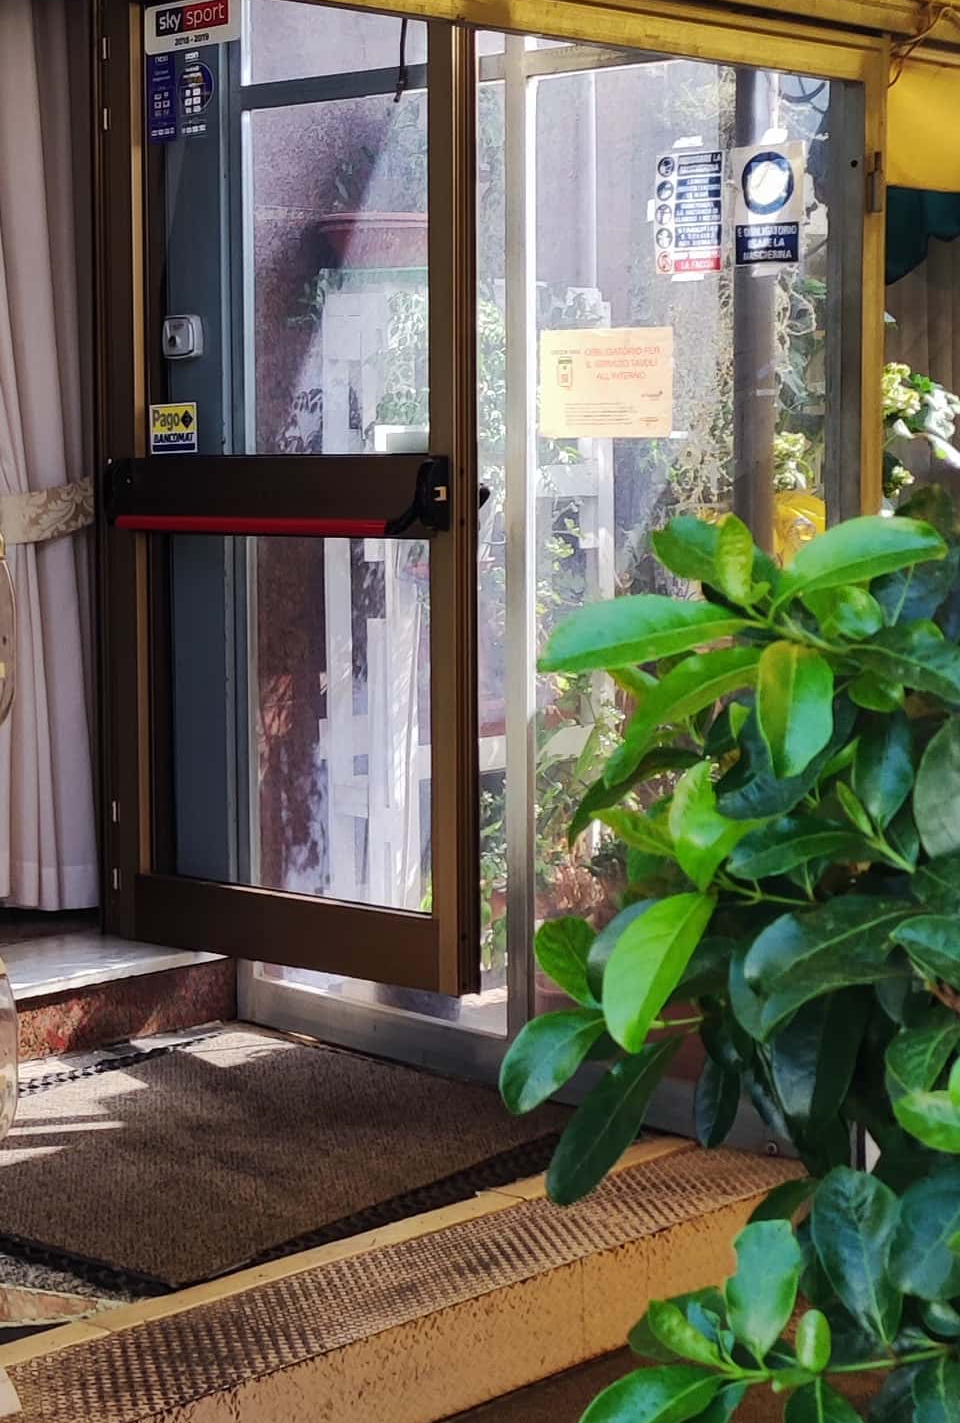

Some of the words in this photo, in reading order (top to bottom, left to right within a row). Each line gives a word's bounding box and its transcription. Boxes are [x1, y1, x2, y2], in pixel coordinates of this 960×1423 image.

[159, 11, 181, 32] sky
[186, 2, 225, 27] sport
[773, 237, 785, 247] LA
[584, 346, 642, 356] OBBLIGATORIO
[152, 409, 180, 432] Pago
[154, 433, 194, 443] BANCOMAT
